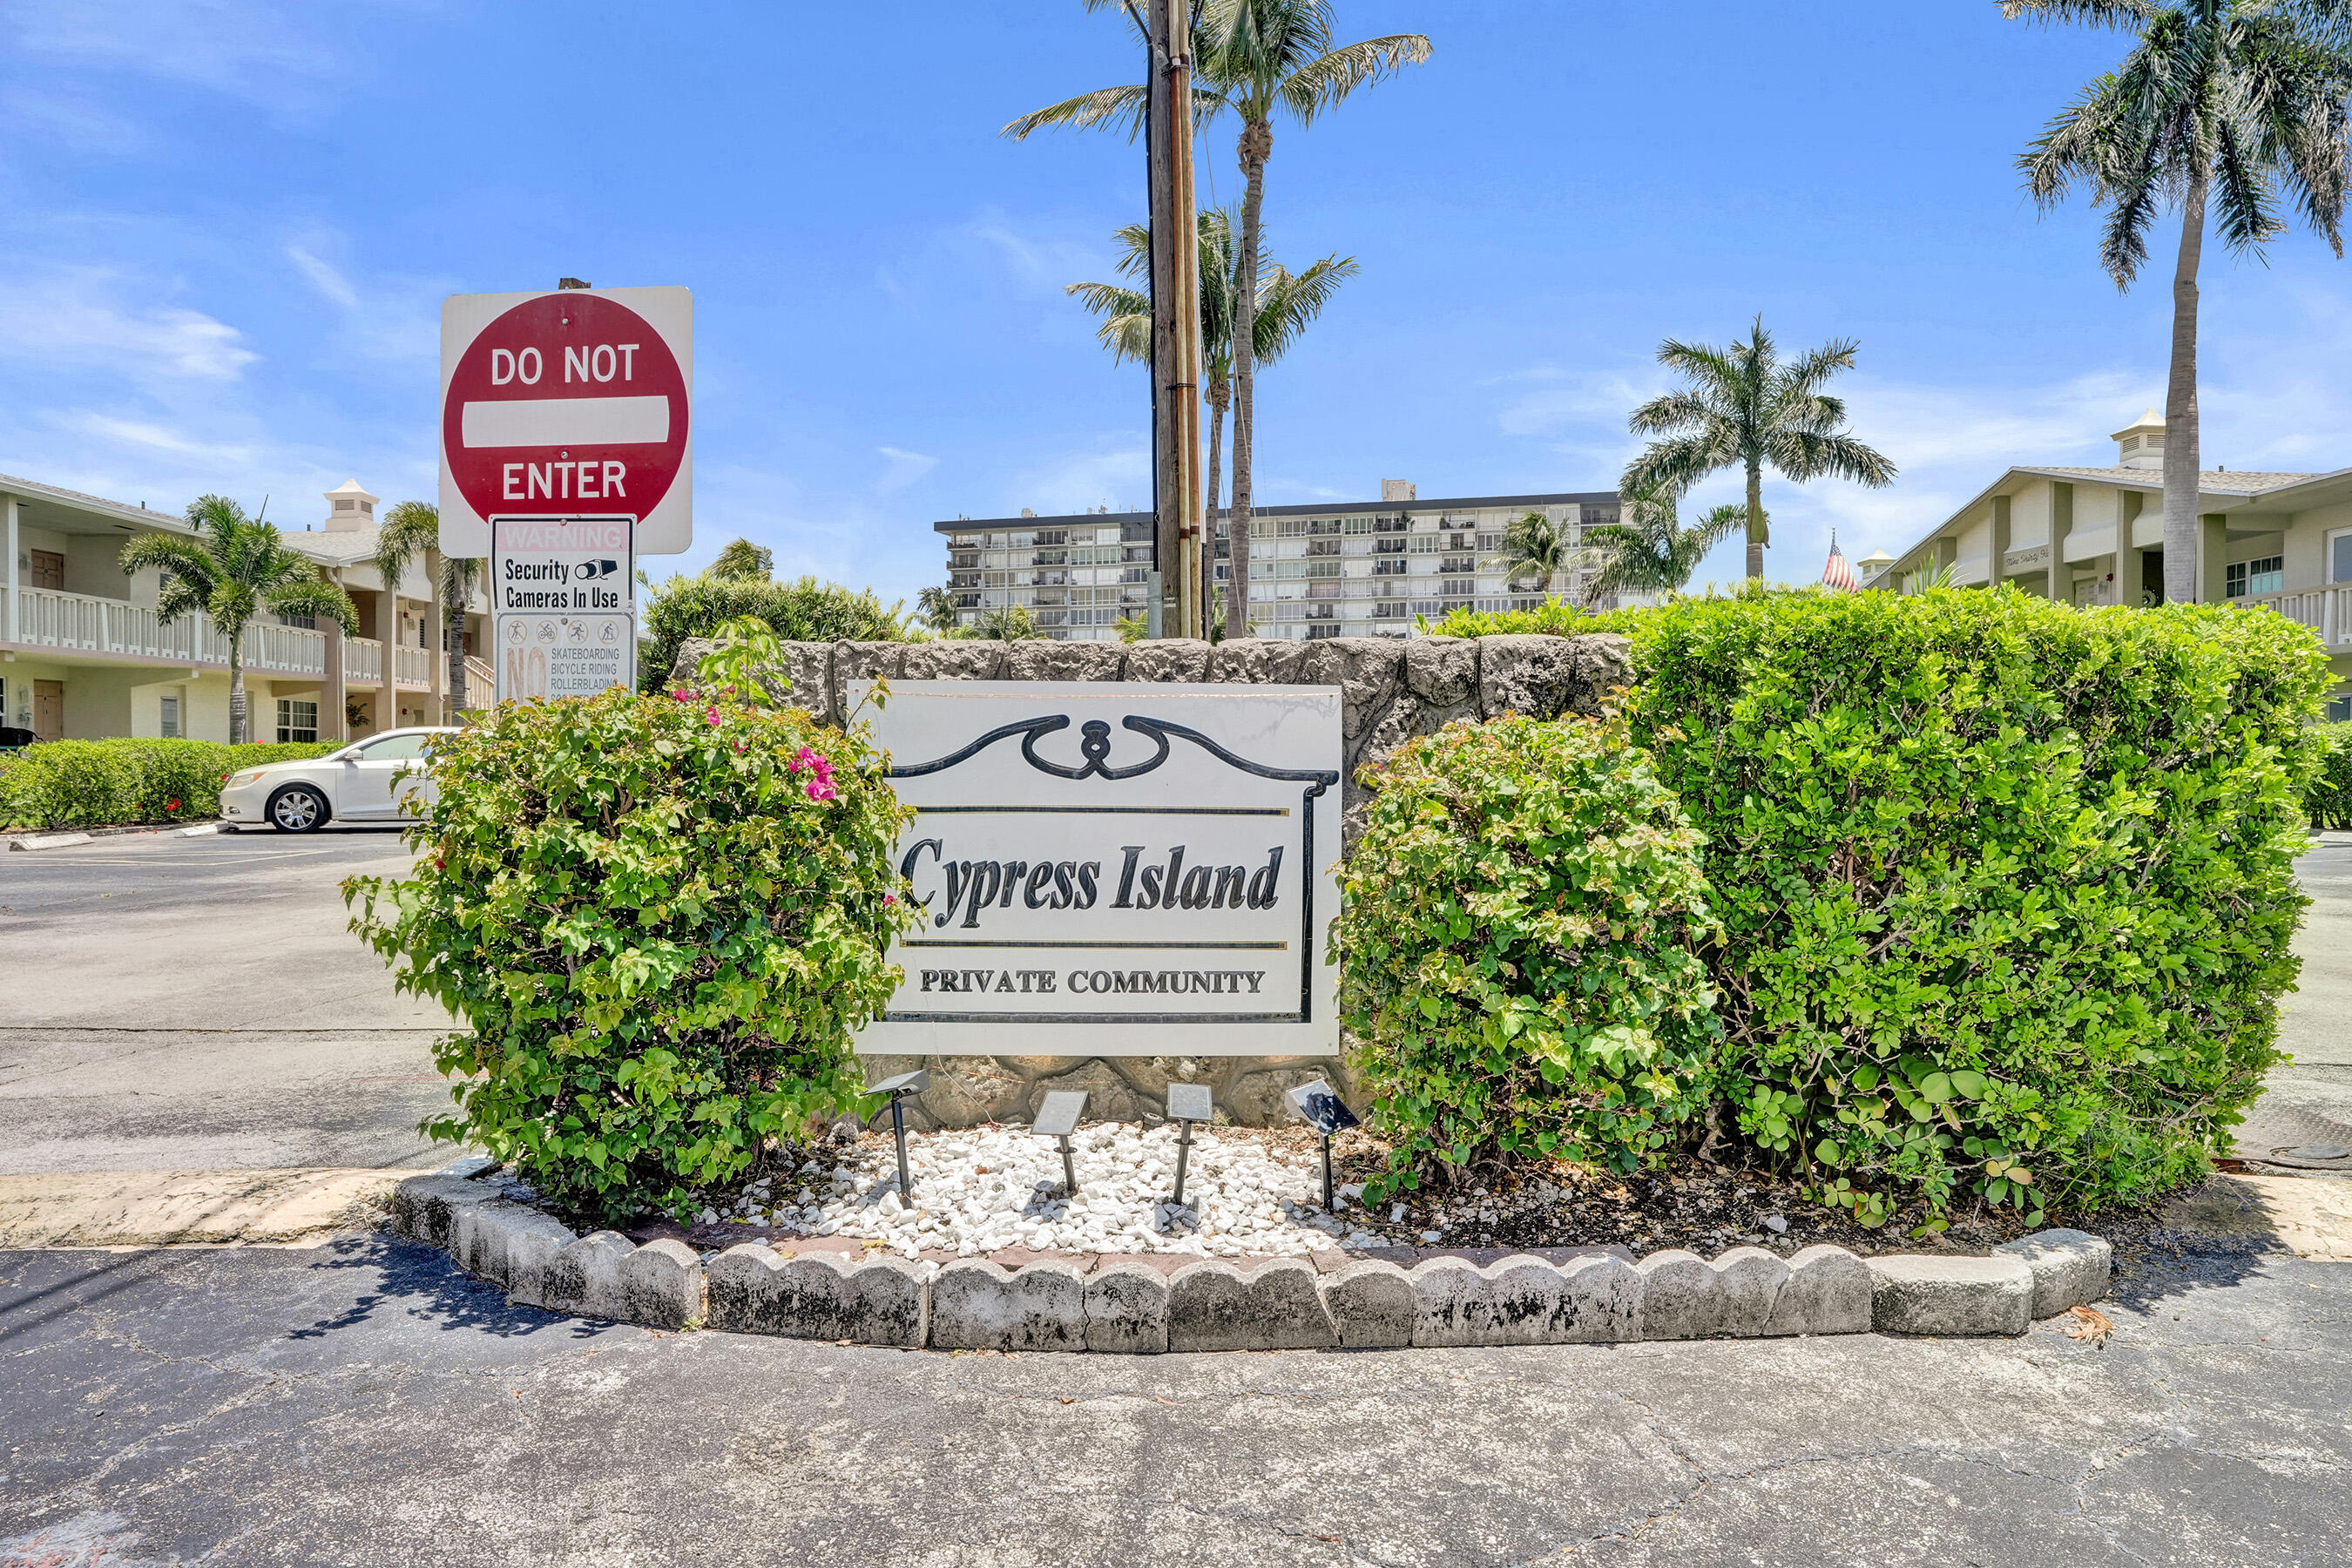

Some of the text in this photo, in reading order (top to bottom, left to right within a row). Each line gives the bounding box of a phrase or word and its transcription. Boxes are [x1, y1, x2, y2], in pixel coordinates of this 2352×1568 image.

[491, 344, 640, 386] DO NOT
[503, 460, 627, 500] ENTER
[504, 525, 622, 549] WARNING
[505, 558, 569, 585] Security
[506, 586, 618, 608] Cameras In Use
[551, 647, 619, 660] SKATEBOARDING
[507, 646, 547, 706] NO
[551, 663, 617, 675] BICYCLE RIDING
[901, 837, 1285, 929] Cypress Island
[919, 969, 1266, 994] PRIVATE COMMUNITY
